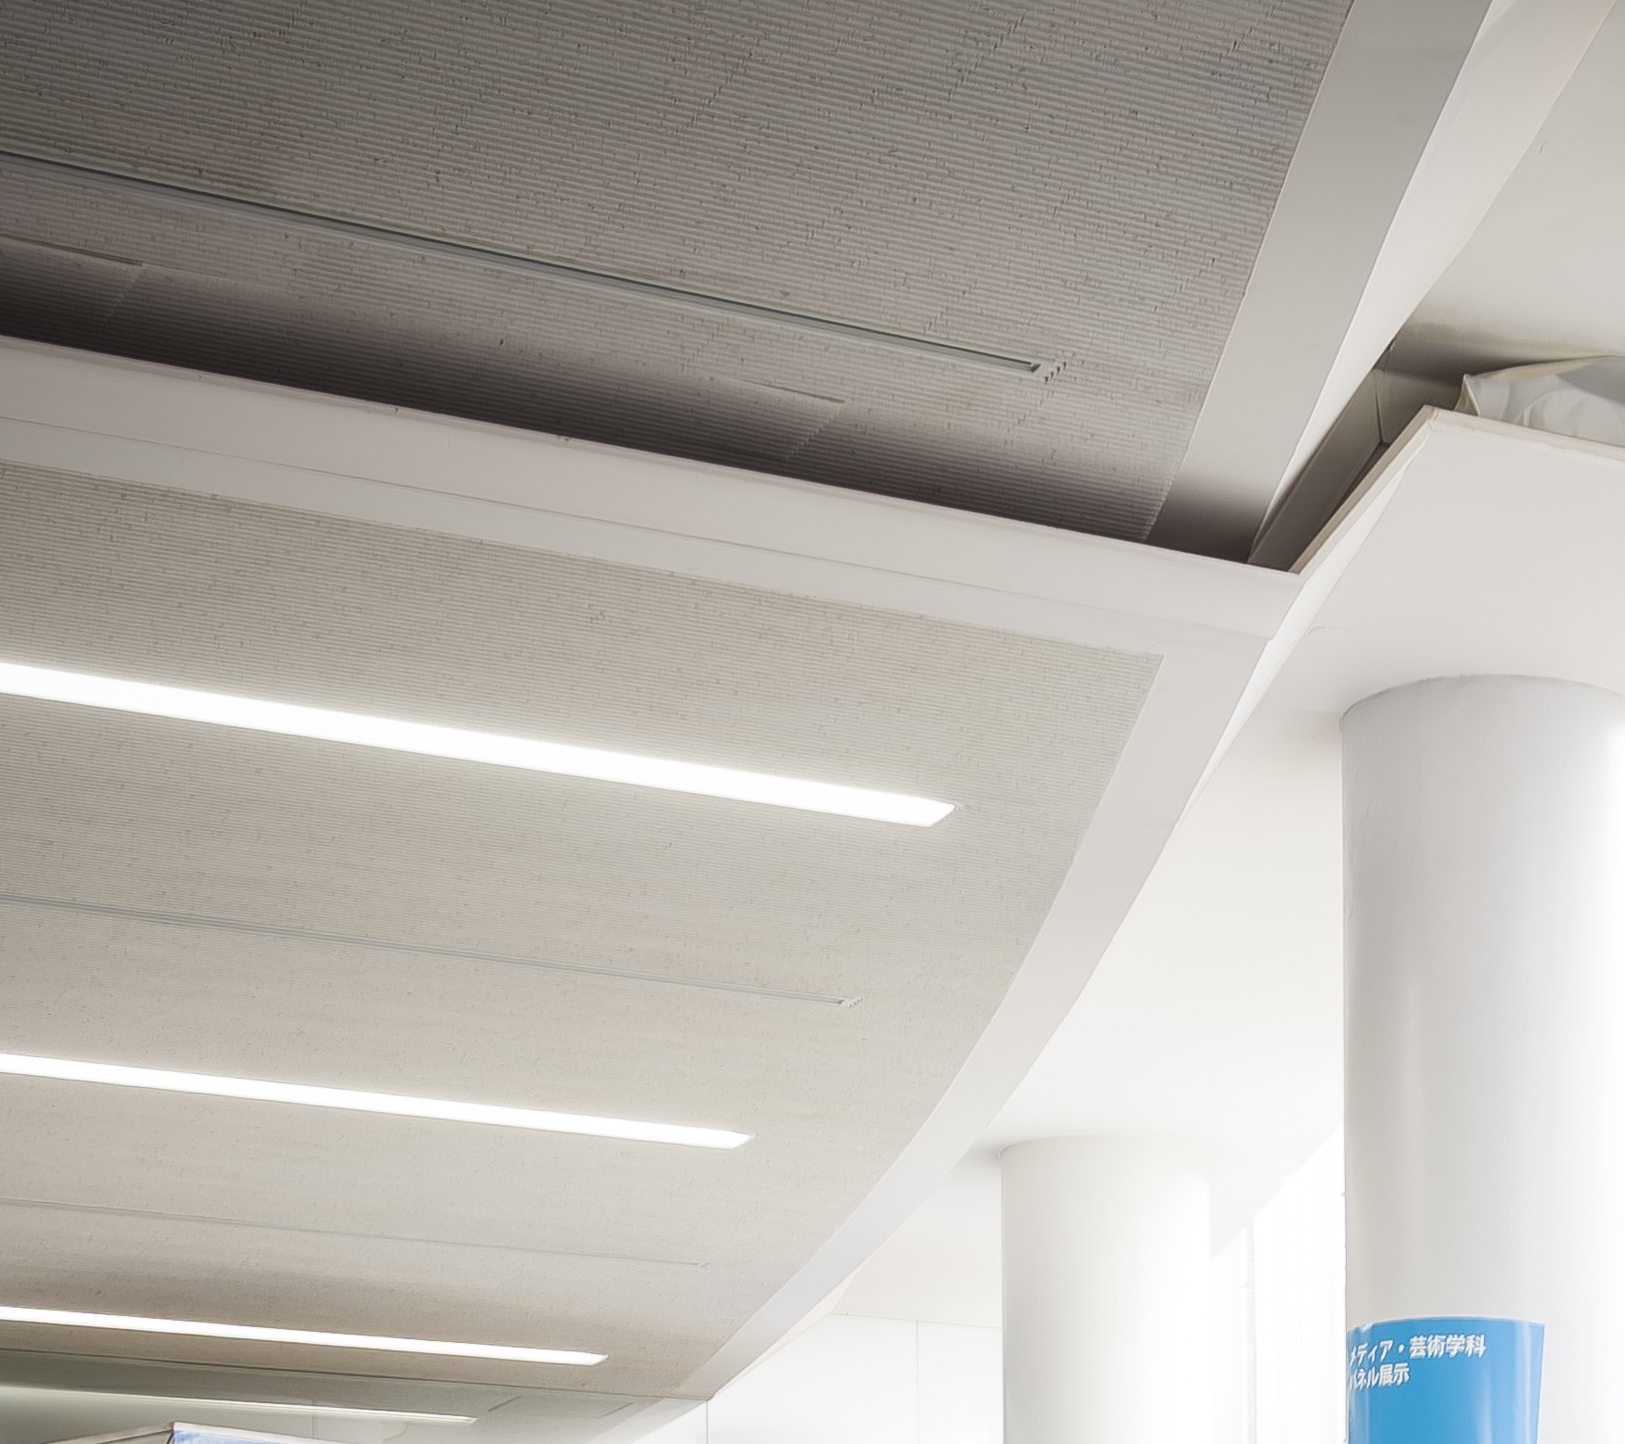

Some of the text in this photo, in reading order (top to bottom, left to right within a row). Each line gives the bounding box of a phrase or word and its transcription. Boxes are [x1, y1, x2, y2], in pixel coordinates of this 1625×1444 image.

[1349, 1334, 1487, 1368] メディア・芸術学科
[1348, 1362, 1410, 1393] パネル展示
